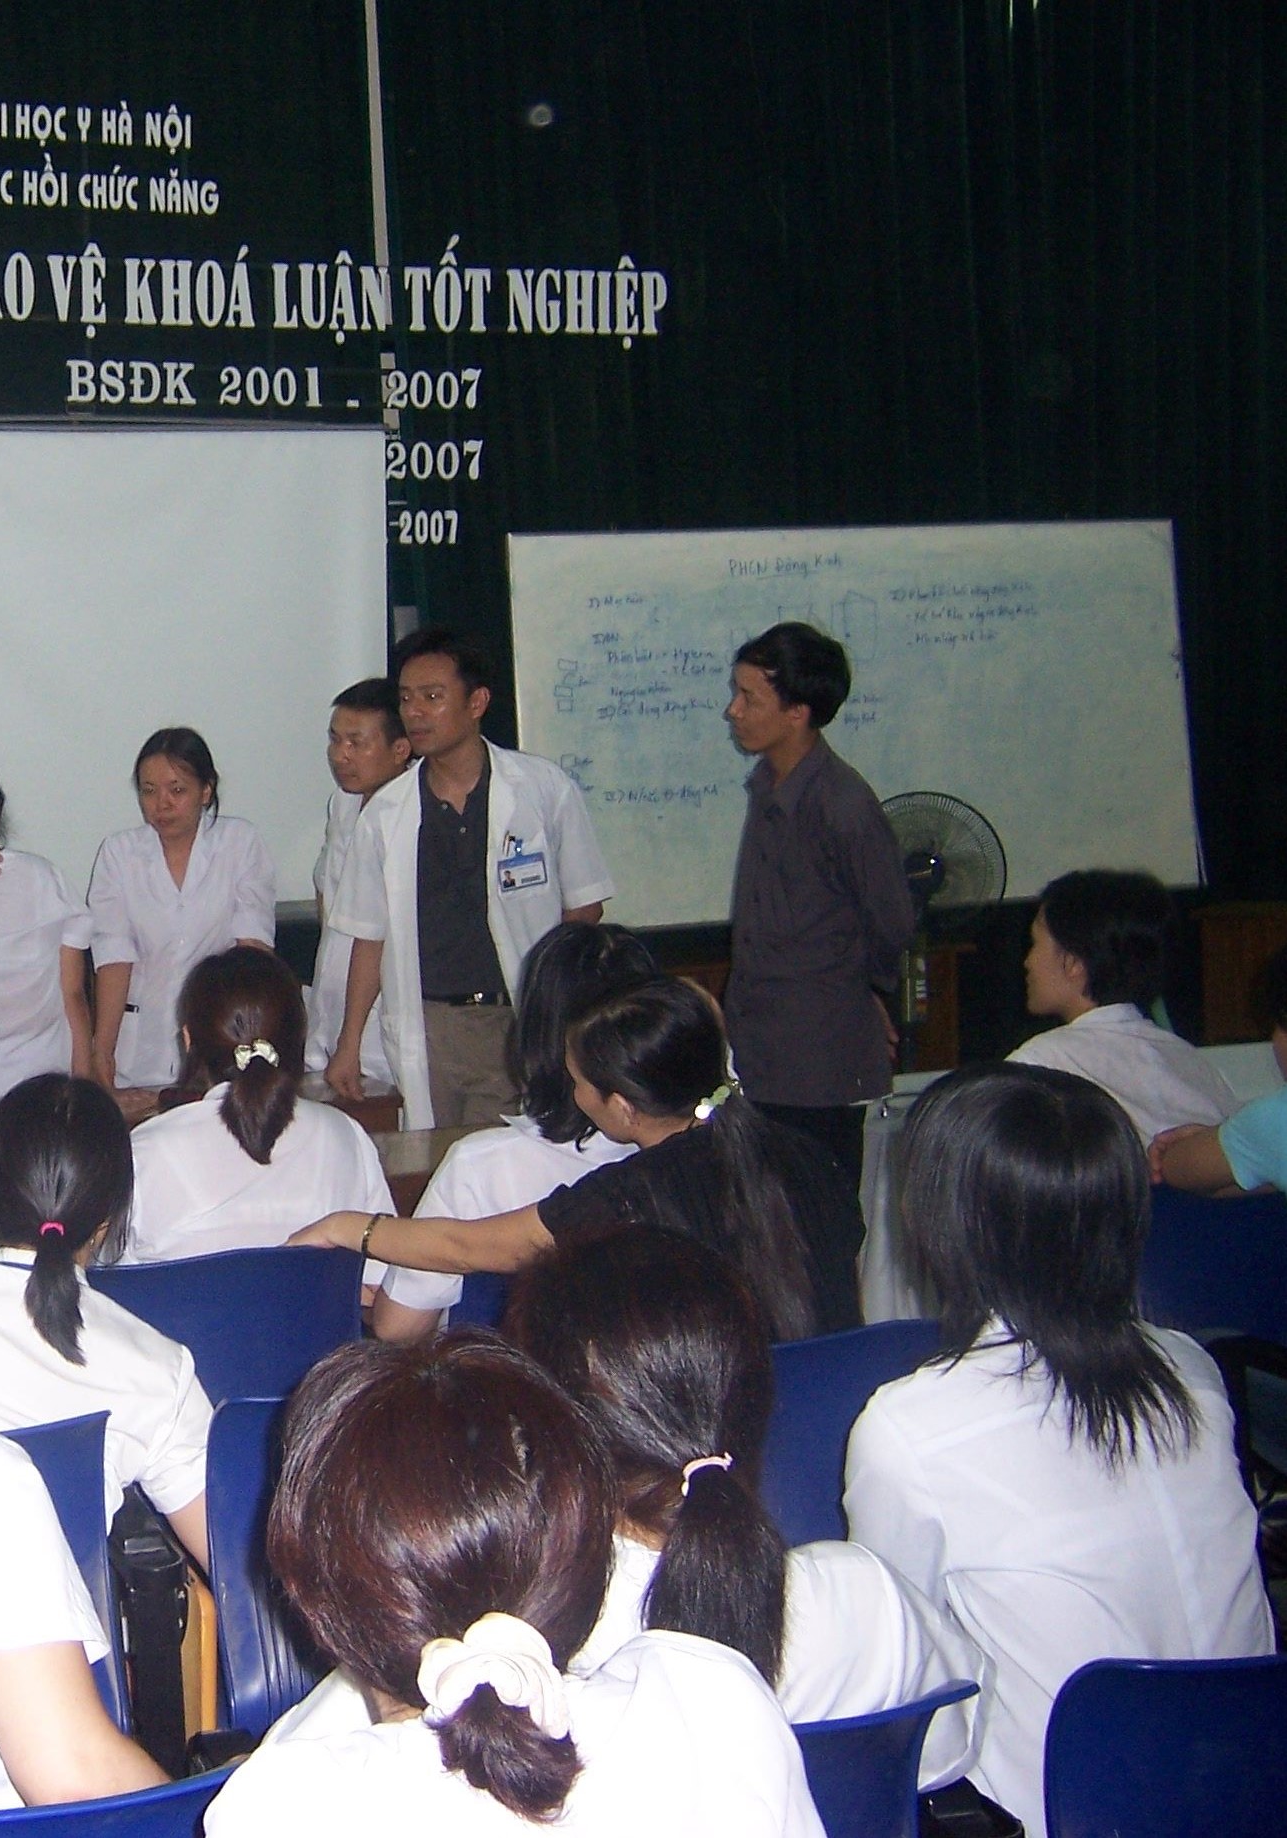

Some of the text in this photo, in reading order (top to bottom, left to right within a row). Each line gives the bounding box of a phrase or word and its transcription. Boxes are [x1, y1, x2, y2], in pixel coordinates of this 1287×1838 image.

[15, 103, 67, 147] HỌC
[77, 106, 91, 142] Y
[101, 100, 133, 146] HÀ
[145, 103, 191, 154] NỘI
[22, 152, 68, 207] HỒI
[78, 164, 139, 211] CHỨC
[149, 168, 219, 215] NĂNG
[47, 242, 107, 339] VỆ
[124, 244, 256, 328] KHOÁ
[271, 250, 390, 346] LUẬN
[404, 234, 492, 334] TỐT
[506, 254, 668, 351] NGHIỆP
[66, 359, 197, 406] BSĐK
[219, 366, 323, 408] 2001
[386, 367, 482, 410] 2007
[386, 439, 484, 481] 2007
